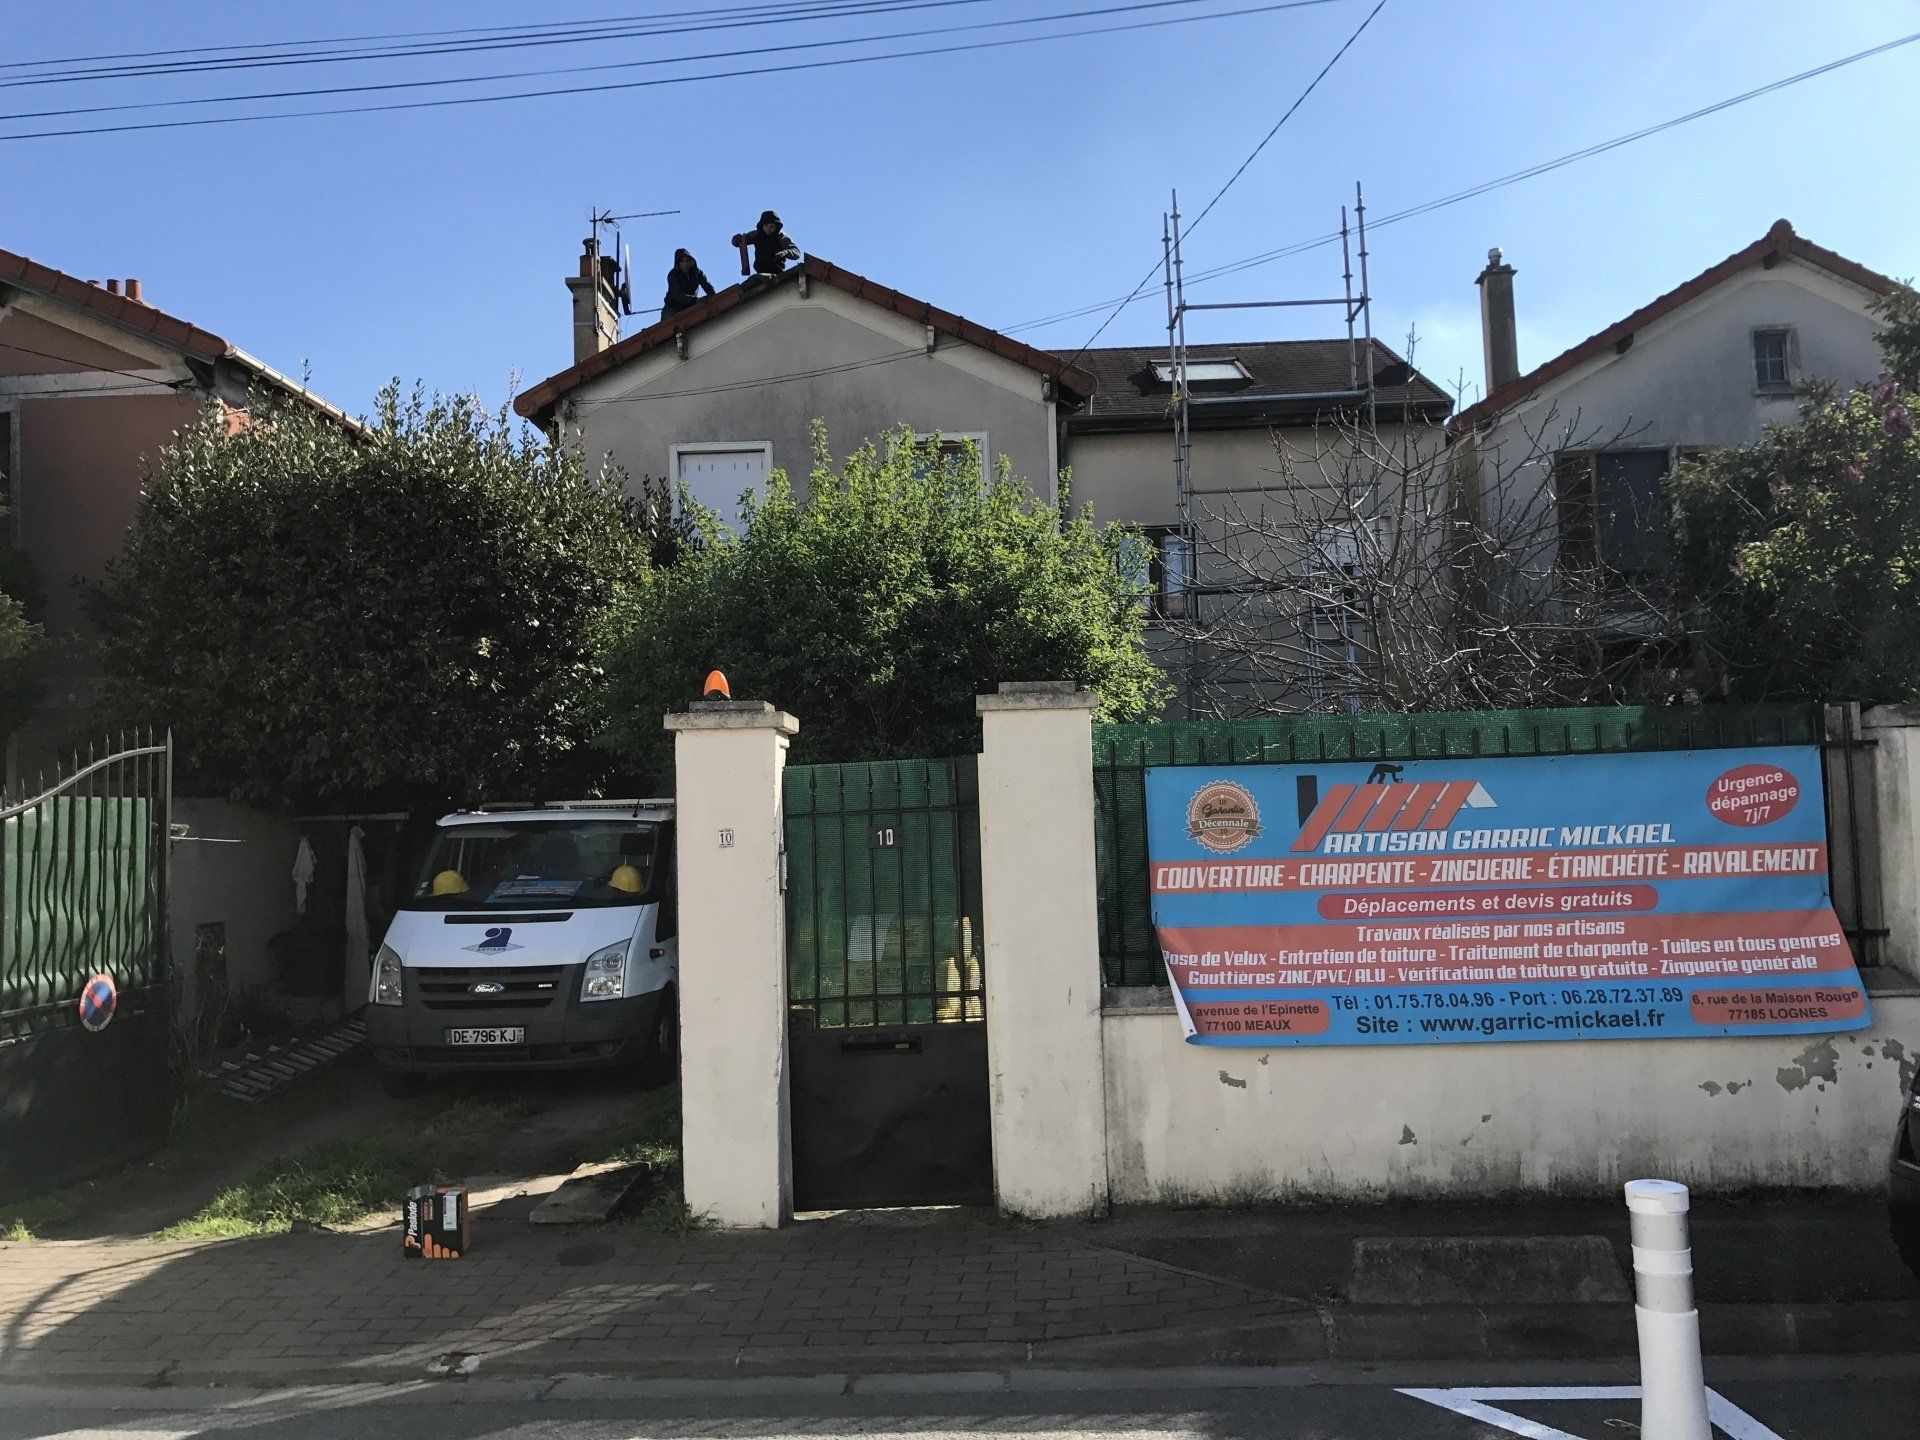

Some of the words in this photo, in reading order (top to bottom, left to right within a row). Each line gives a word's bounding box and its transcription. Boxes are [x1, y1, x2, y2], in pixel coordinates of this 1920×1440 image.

[1718, 772, 1783, 793] Urgence
[1711, 786, 1797, 811] dépannage
[1202, 803, 1245, 817] Garantie
[1744, 805, 1771, 824] 7j/7
[1198, 819, 1249, 829] Décennale
[719, 832, 732, 845] 10
[876, 828, 894, 846] 10
[1324, 831, 1448, 854] ARTISAN
[1453, 827, 1556, 850] GARRIC
[1560, 823, 1677, 846] MICKAEL
[1157, 865, 1285, 889] COUVERTURE
[1299, 861, 1416, 886] CHARPENTE
[1430, 857, 1534, 883] ZINGUERIE
[1548, 849, 1670, 878] ÉTANCHÉITÉ
[1684, 848, 1819, 874] RAVALEMENT
[1344, 896, 1475, 916] Déplacements
[1482, 895, 1500, 910] et
[1505, 893, 1554, 909] devis
[1561, 891, 1633, 911] gratuits
[1356, 926, 1421, 942] Travaux
[1424, 923, 1490, 940] réalisés
[1493, 924, 1520, 941] par
[1524, 923, 1553, 937] nos
[1556, 920, 1625, 936] artisans
[1201, 952, 1220, 966] de
[1224, 951, 1267, 966] Velux
[1279, 948, 1354, 965] Entretien
[1357, 948, 1377, 964] de
[1380, 947, 1436, 962] toiture
[1449, 943, 1540, 961] Traitement
[1543, 942, 1563, 958] de
[1566, 940, 1648, 959] charpente
[1660, 938, 1711, 955] Tuiles
[1714, 939, 1734, 953] en
[1737, 936, 1776, 951] tous
[1779, 933, 1841, 952] genres
[1188, 969, 1275, 985] Gouttières
[1398, 966, 1493, 982] Vérification
[1496, 965, 1516, 980] de
[1519, 963, 1577, 979] toiture
[1580, 961, 1648, 979] gratuite
[1659, 958, 1739, 976] Zinguerie
[1741, 954, 1818, 974] générale
[475, 984, 496, 993] Ford
[1332, 995, 1358, 1010] Tél
[1374, 992, 1495, 1010] 01.75.78.04.96
[1509, 991, 1547, 1006] Port
[1561, 987, 1683, 1005] 06.28.72.37.89
[1691, 994, 1704, 1006] 6,
[1707, 996, 1728, 1004] rue
[1732, 993, 1747, 1004] de
[1751, 993, 1762, 1003] la
[1766, 992, 1812, 1004] Maison
[1816, 990, 1858, 1005] Rouge
[1196, 1007, 1240, 1017] avenue
[1243, 1005, 1258, 1015] de
[1728, 1008, 1766, 1020] 77185
[1769, 1007, 1828, 1019] LOGNES
[1206, 1021, 1241, 1031] 77100
[1245, 1020, 1292, 1031] MEAUX
[1356, 1015, 1399, 1034] Site
[1420, 1008, 1665, 1036] www.garric-mickael.fr
[453, 1029, 516, 1044] DE-796-KJ
[408, 1201, 418, 1237] Paslode
